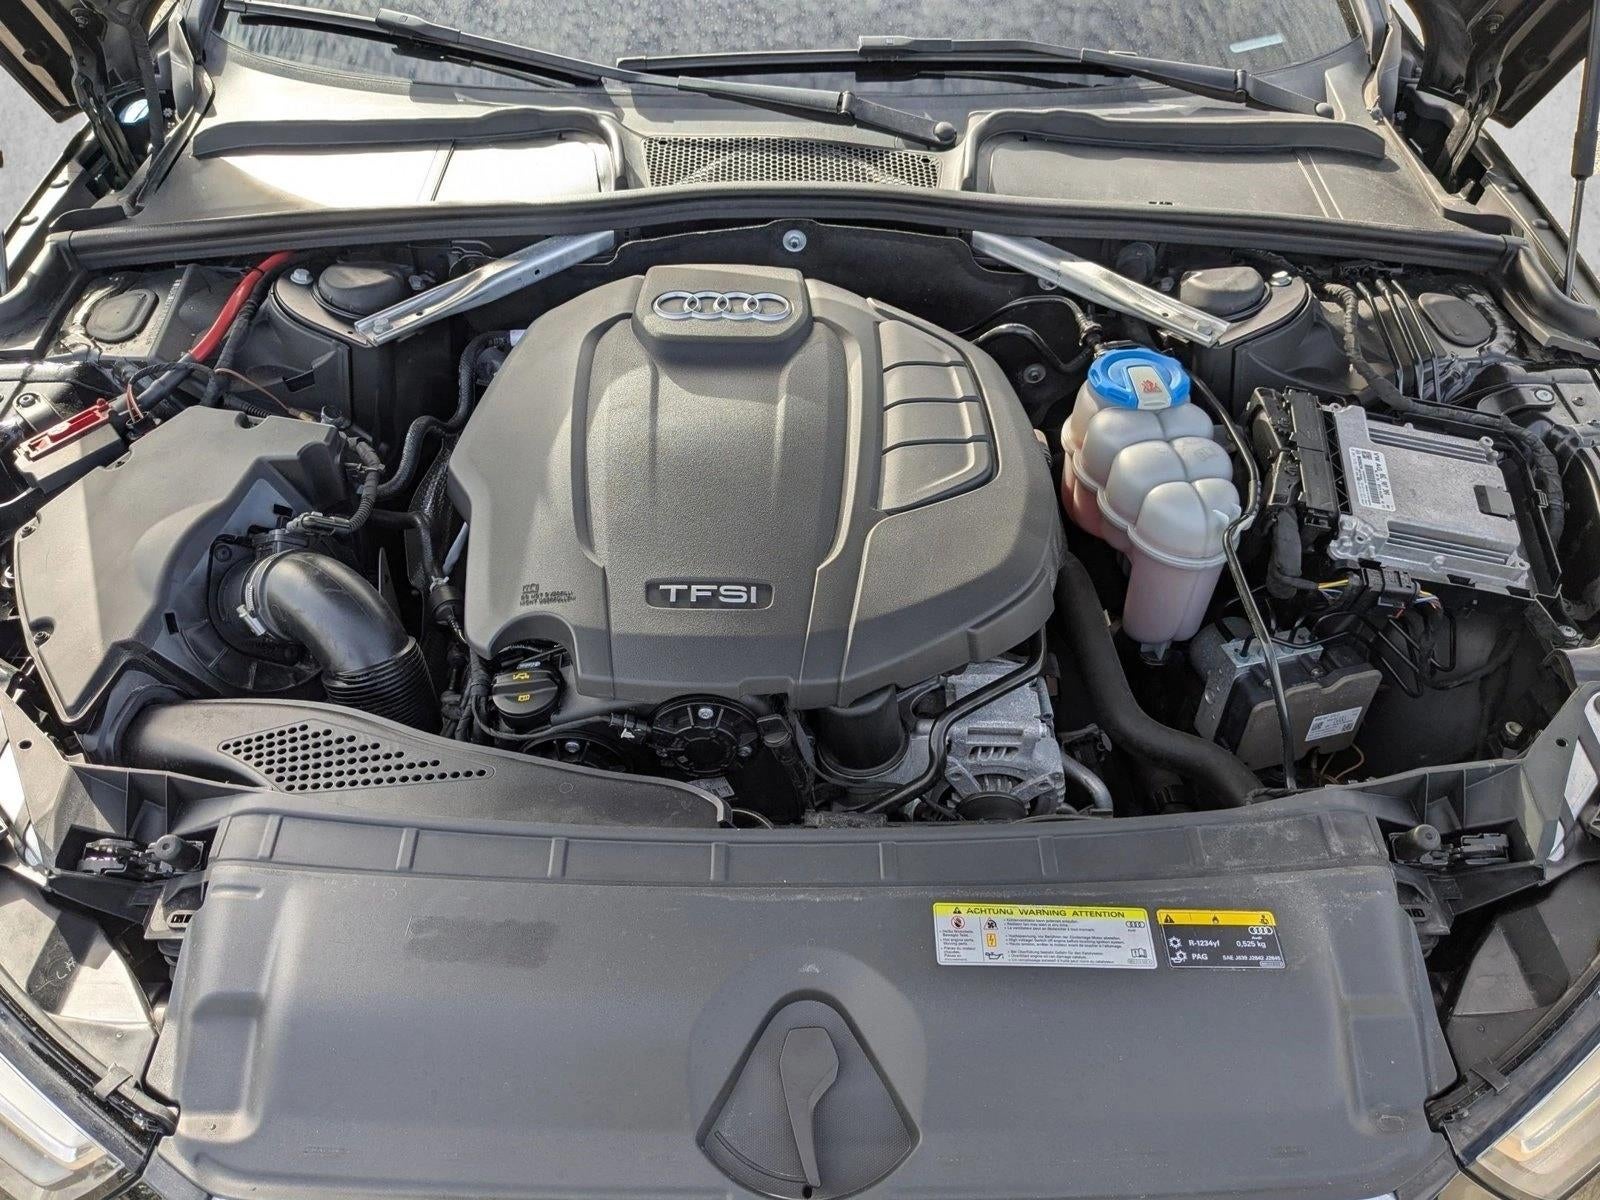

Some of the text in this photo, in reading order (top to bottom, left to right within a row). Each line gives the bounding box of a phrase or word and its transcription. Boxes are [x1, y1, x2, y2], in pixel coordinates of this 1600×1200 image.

[659, 584, 757, 603] TFSI
[966, 907, 1125, 918] ACHTUNG WARNING ATTENTION
[1236, 940, 1267, 949] 0,525 kg
[1191, 952, 1208, 961] PAG
